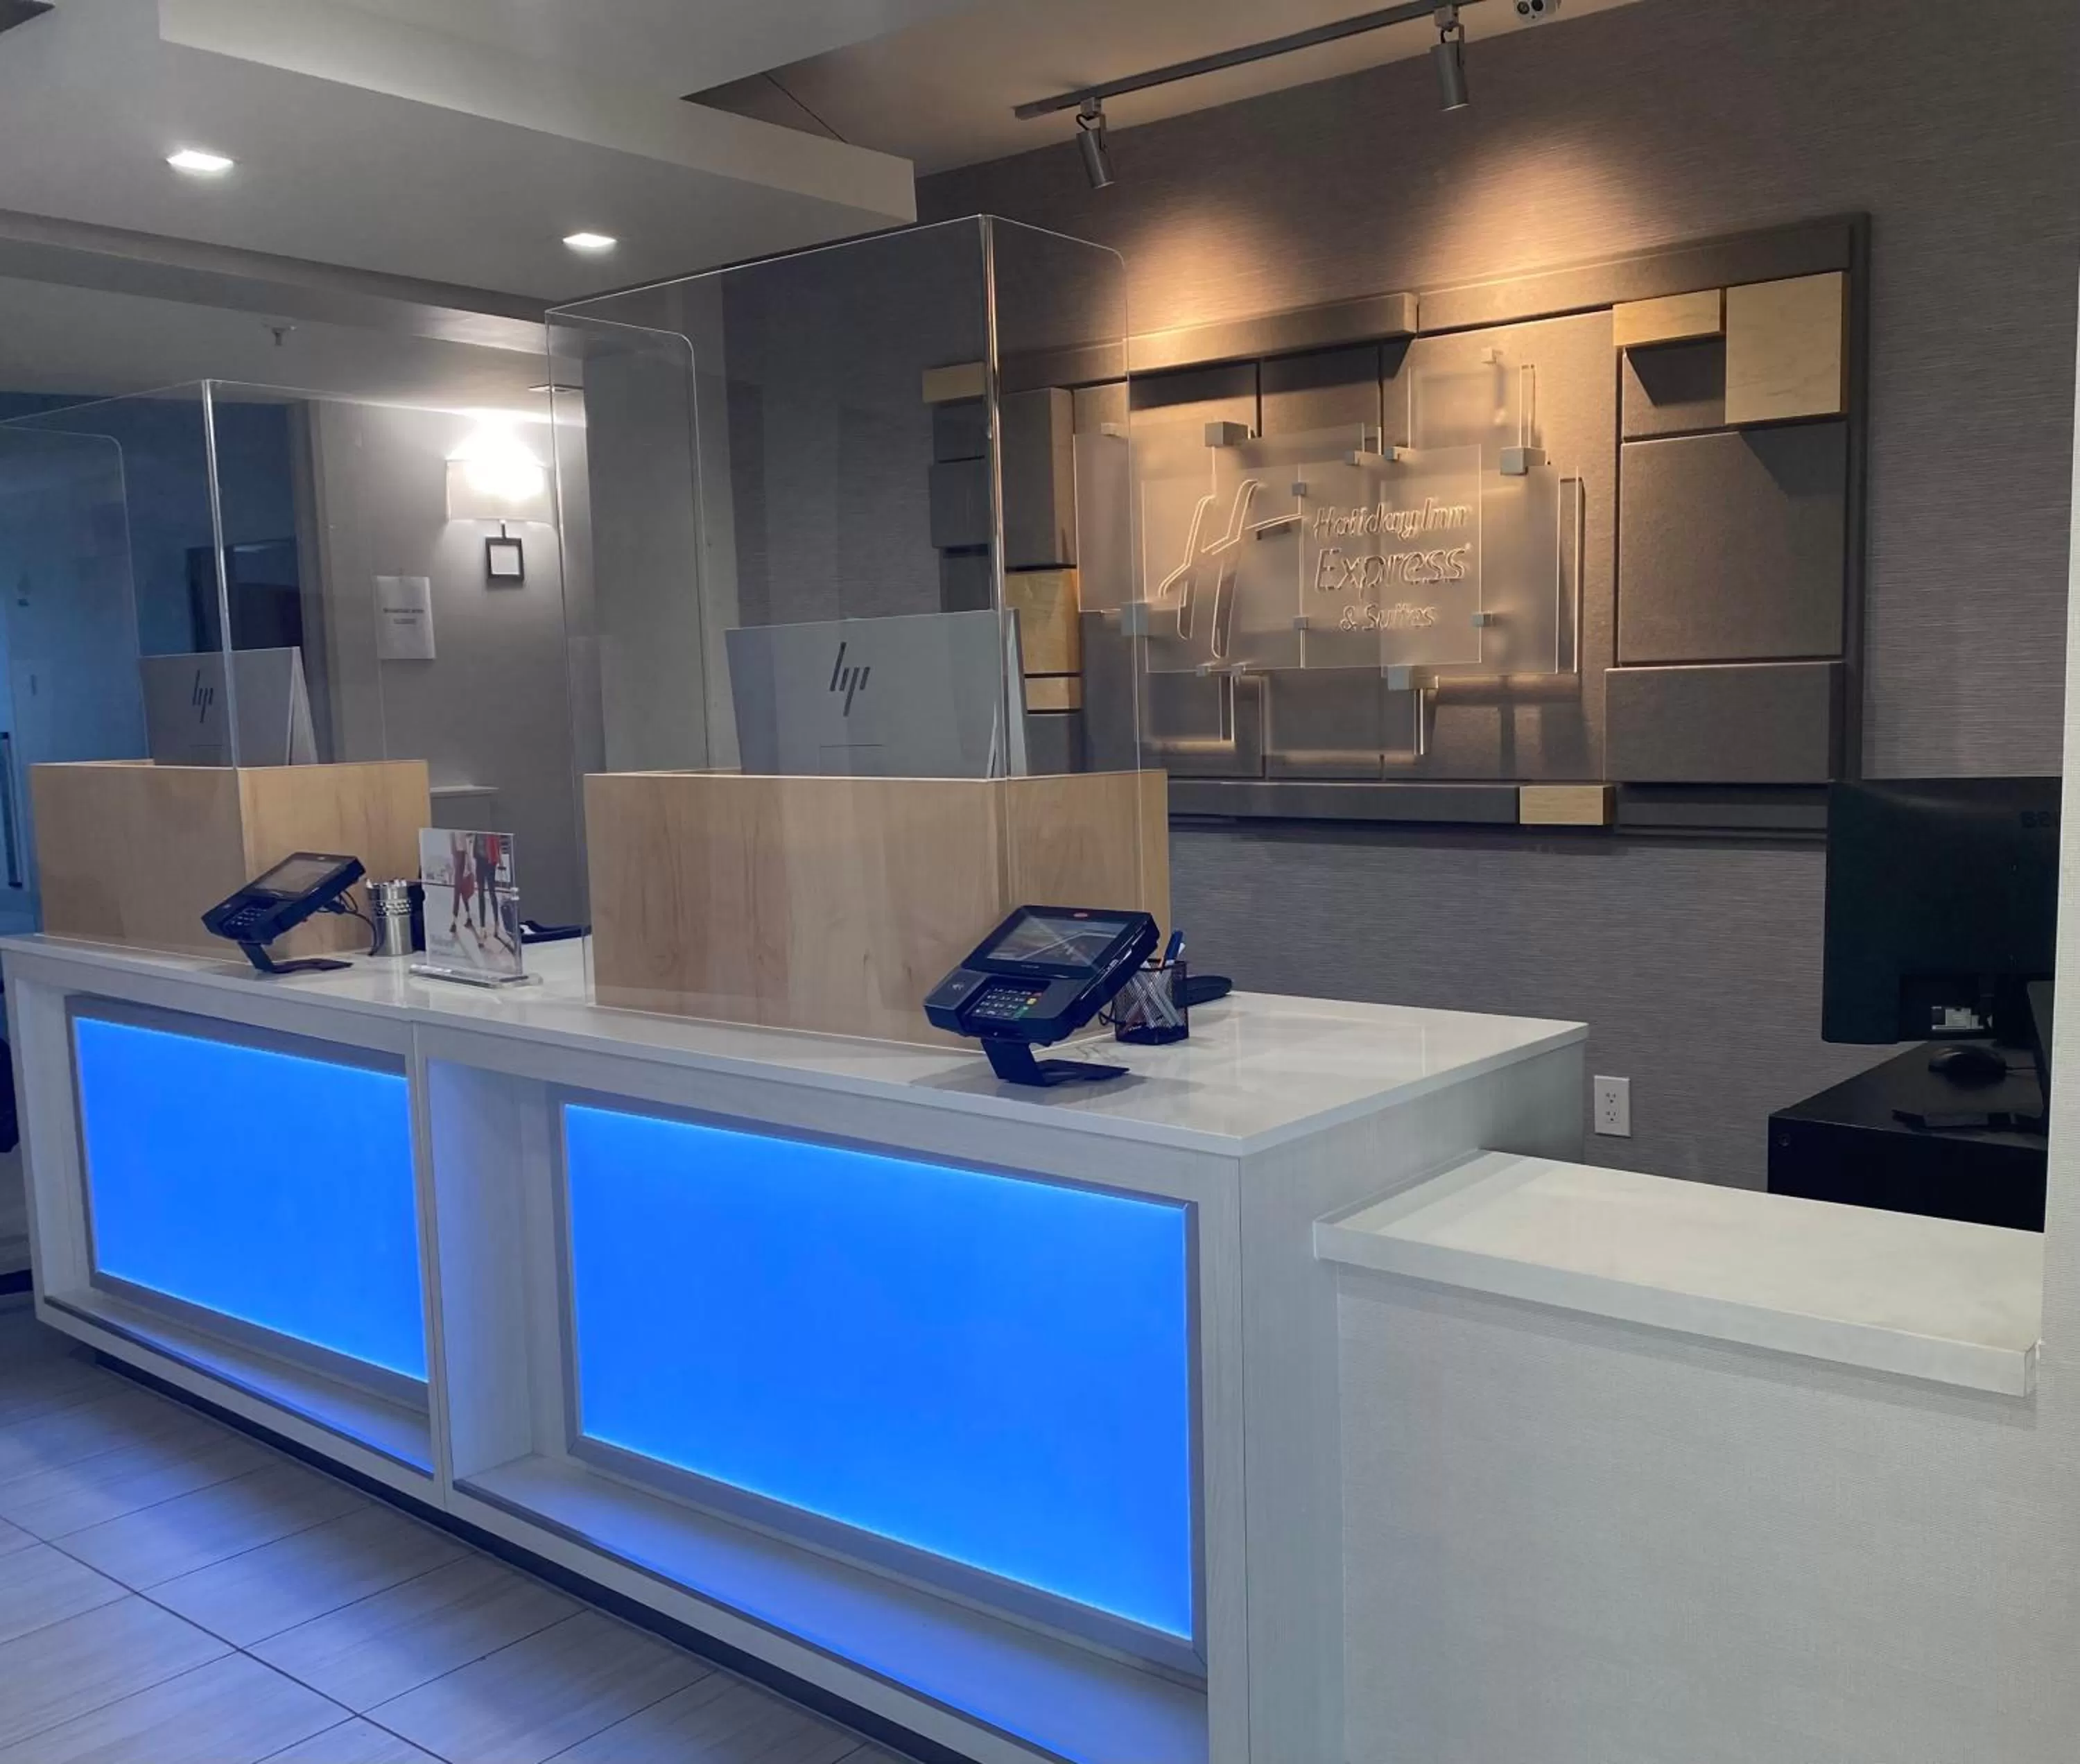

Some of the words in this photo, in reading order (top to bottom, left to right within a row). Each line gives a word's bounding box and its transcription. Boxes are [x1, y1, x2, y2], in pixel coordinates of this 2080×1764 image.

[1315, 548, 1466, 600] Express
[1340, 605, 1357, 632] &
[1362, 603, 1437, 631] Suites
[192, 668, 214, 724] hp
[829, 641, 870, 717] hp
